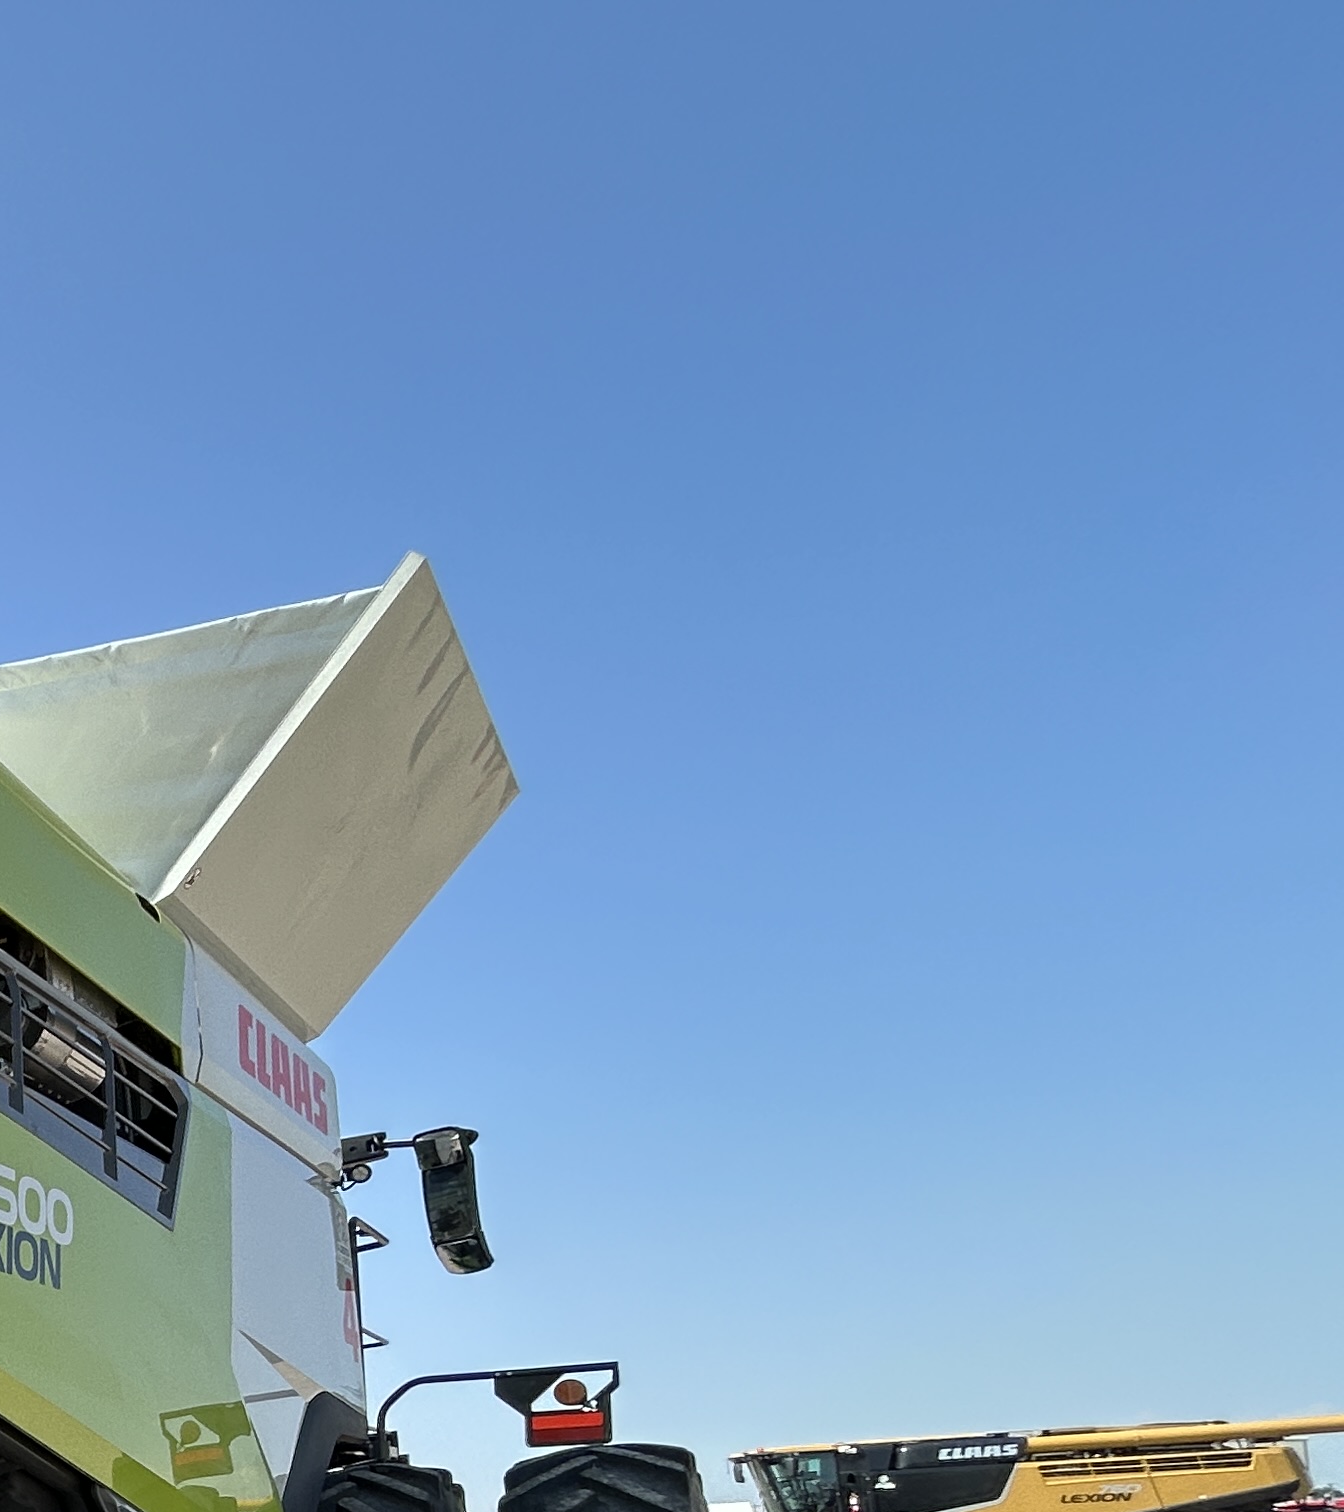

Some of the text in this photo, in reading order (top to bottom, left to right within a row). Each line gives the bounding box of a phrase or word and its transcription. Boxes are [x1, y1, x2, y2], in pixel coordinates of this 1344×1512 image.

[238, 1004, 329, 1136] CLAAS
[342, 1277, 360, 1363] 4
[938, 1443, 1019, 1461] CLAAS
[1060, 1493, 1133, 1504] LEXION
